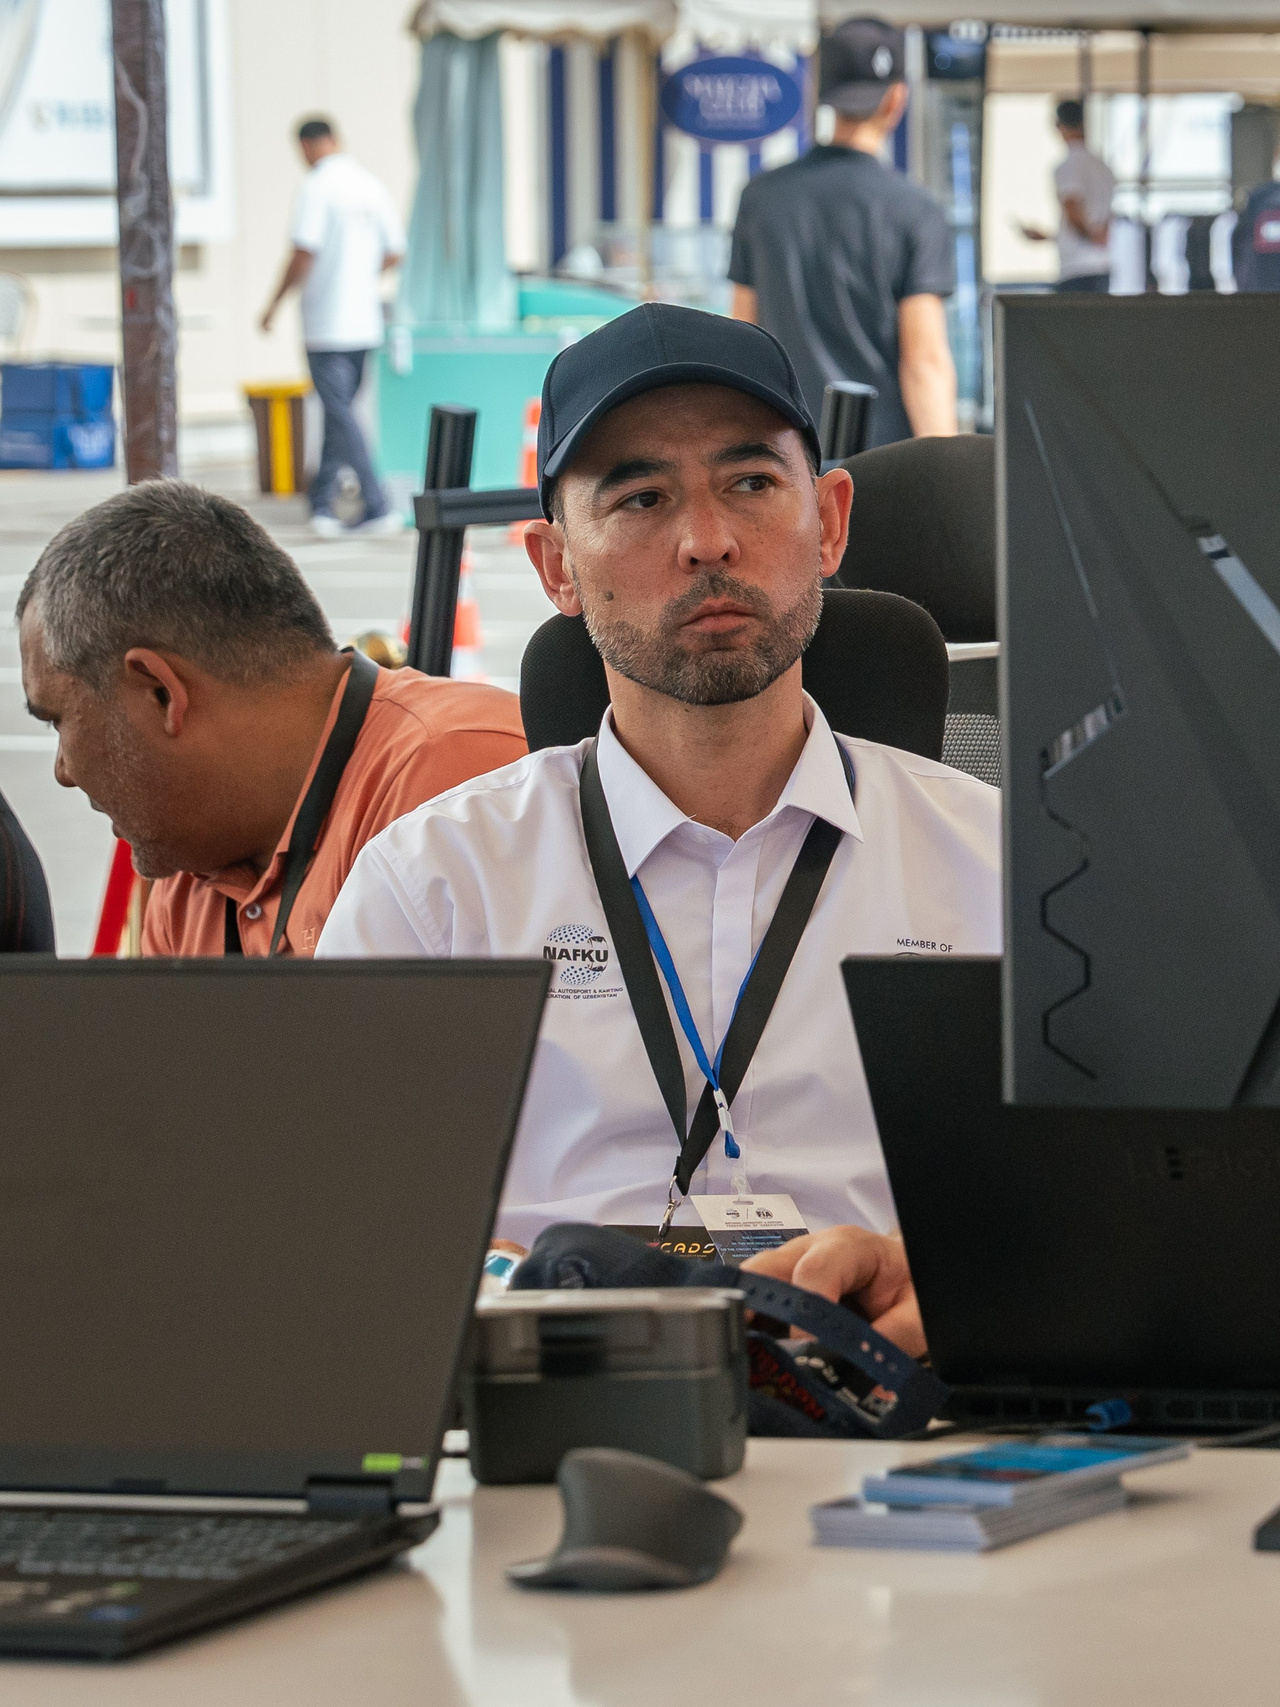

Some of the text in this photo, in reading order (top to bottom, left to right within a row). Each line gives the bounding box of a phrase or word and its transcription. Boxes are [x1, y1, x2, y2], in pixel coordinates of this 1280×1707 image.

[896, 938, 953, 953] MEMBER OF
[542, 945, 609, 963] NAFKU
[755, 1210, 772, 1218] FIA
